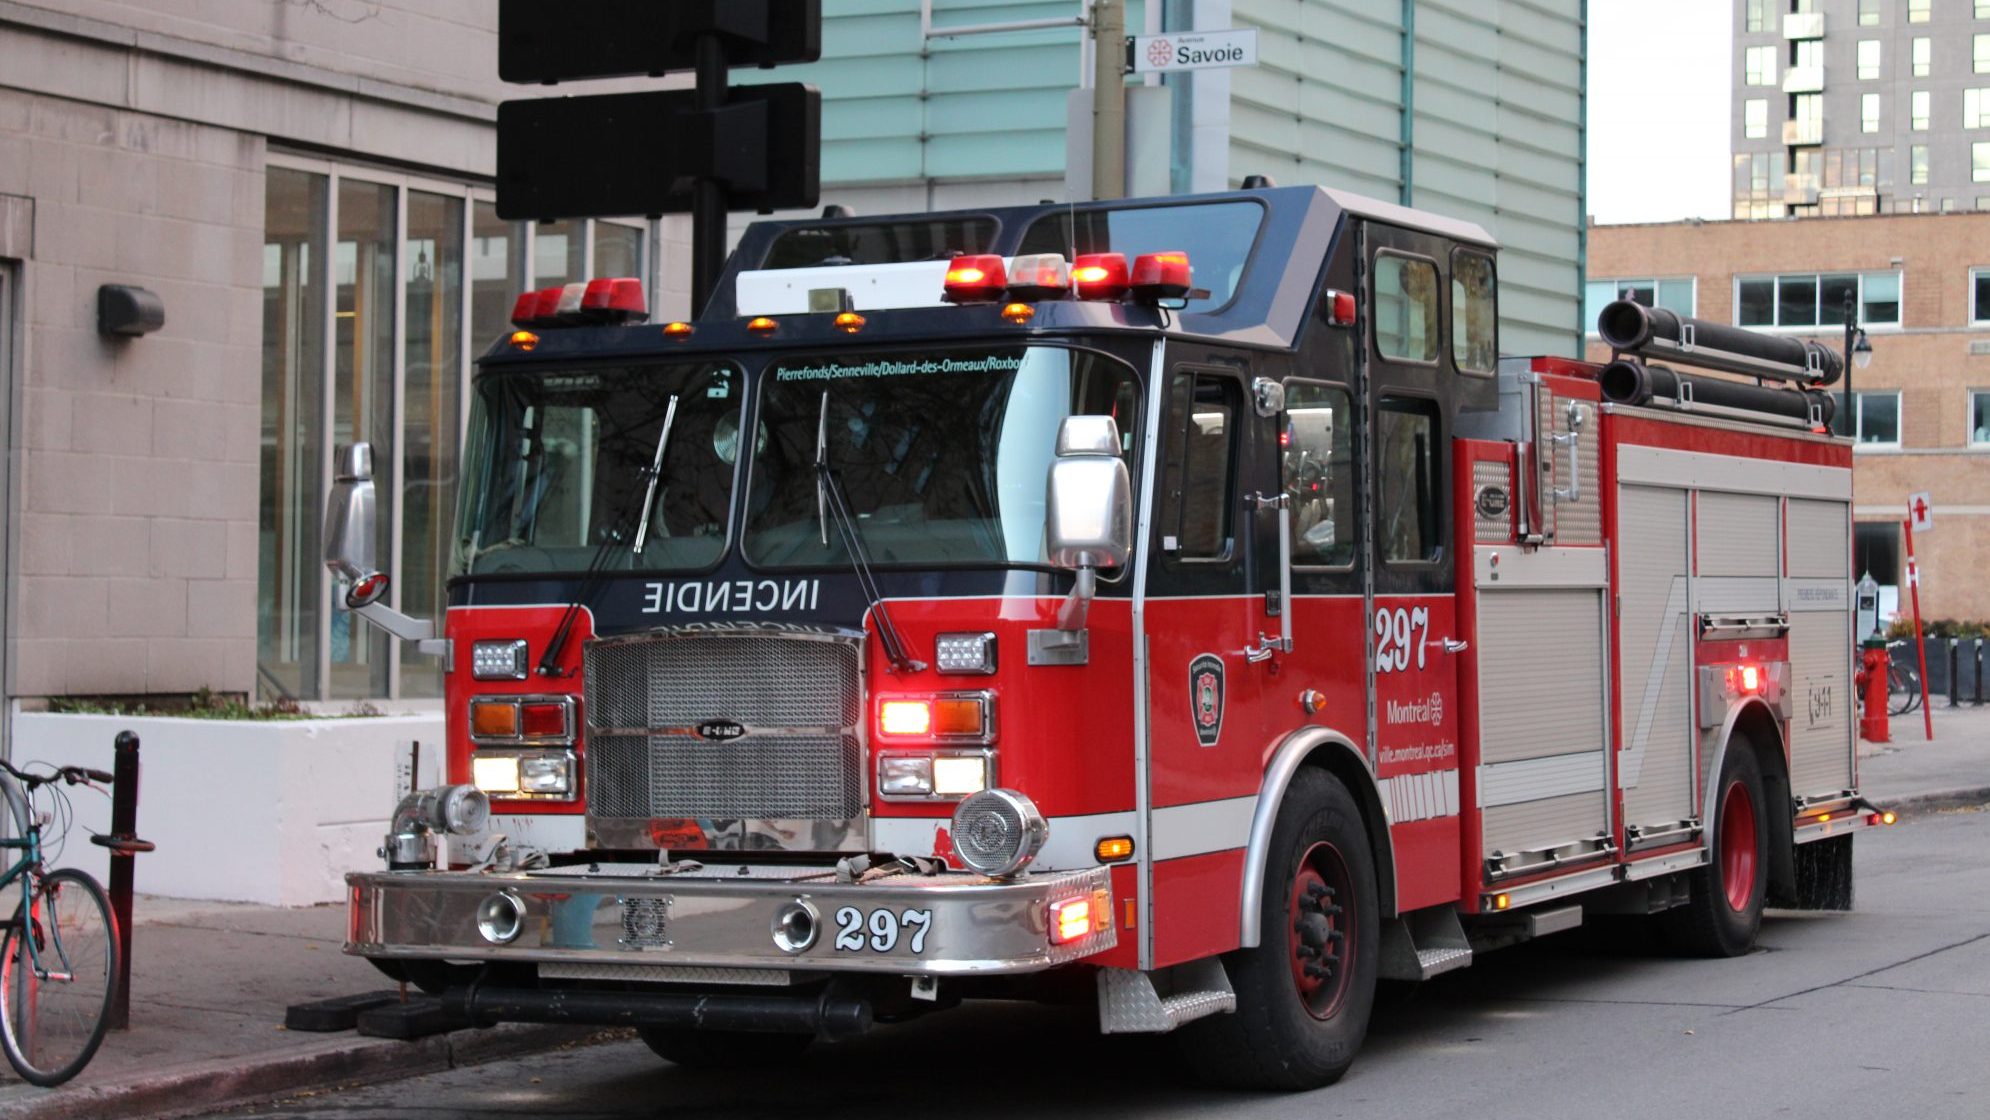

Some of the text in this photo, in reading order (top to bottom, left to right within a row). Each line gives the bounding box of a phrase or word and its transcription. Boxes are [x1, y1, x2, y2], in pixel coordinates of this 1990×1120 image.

[1177, 43, 1243, 64] Savoie
[1375, 606, 1429, 673] 297
[1387, 698, 1430, 724] Montréal
[835, 905, 932, 954] 297
